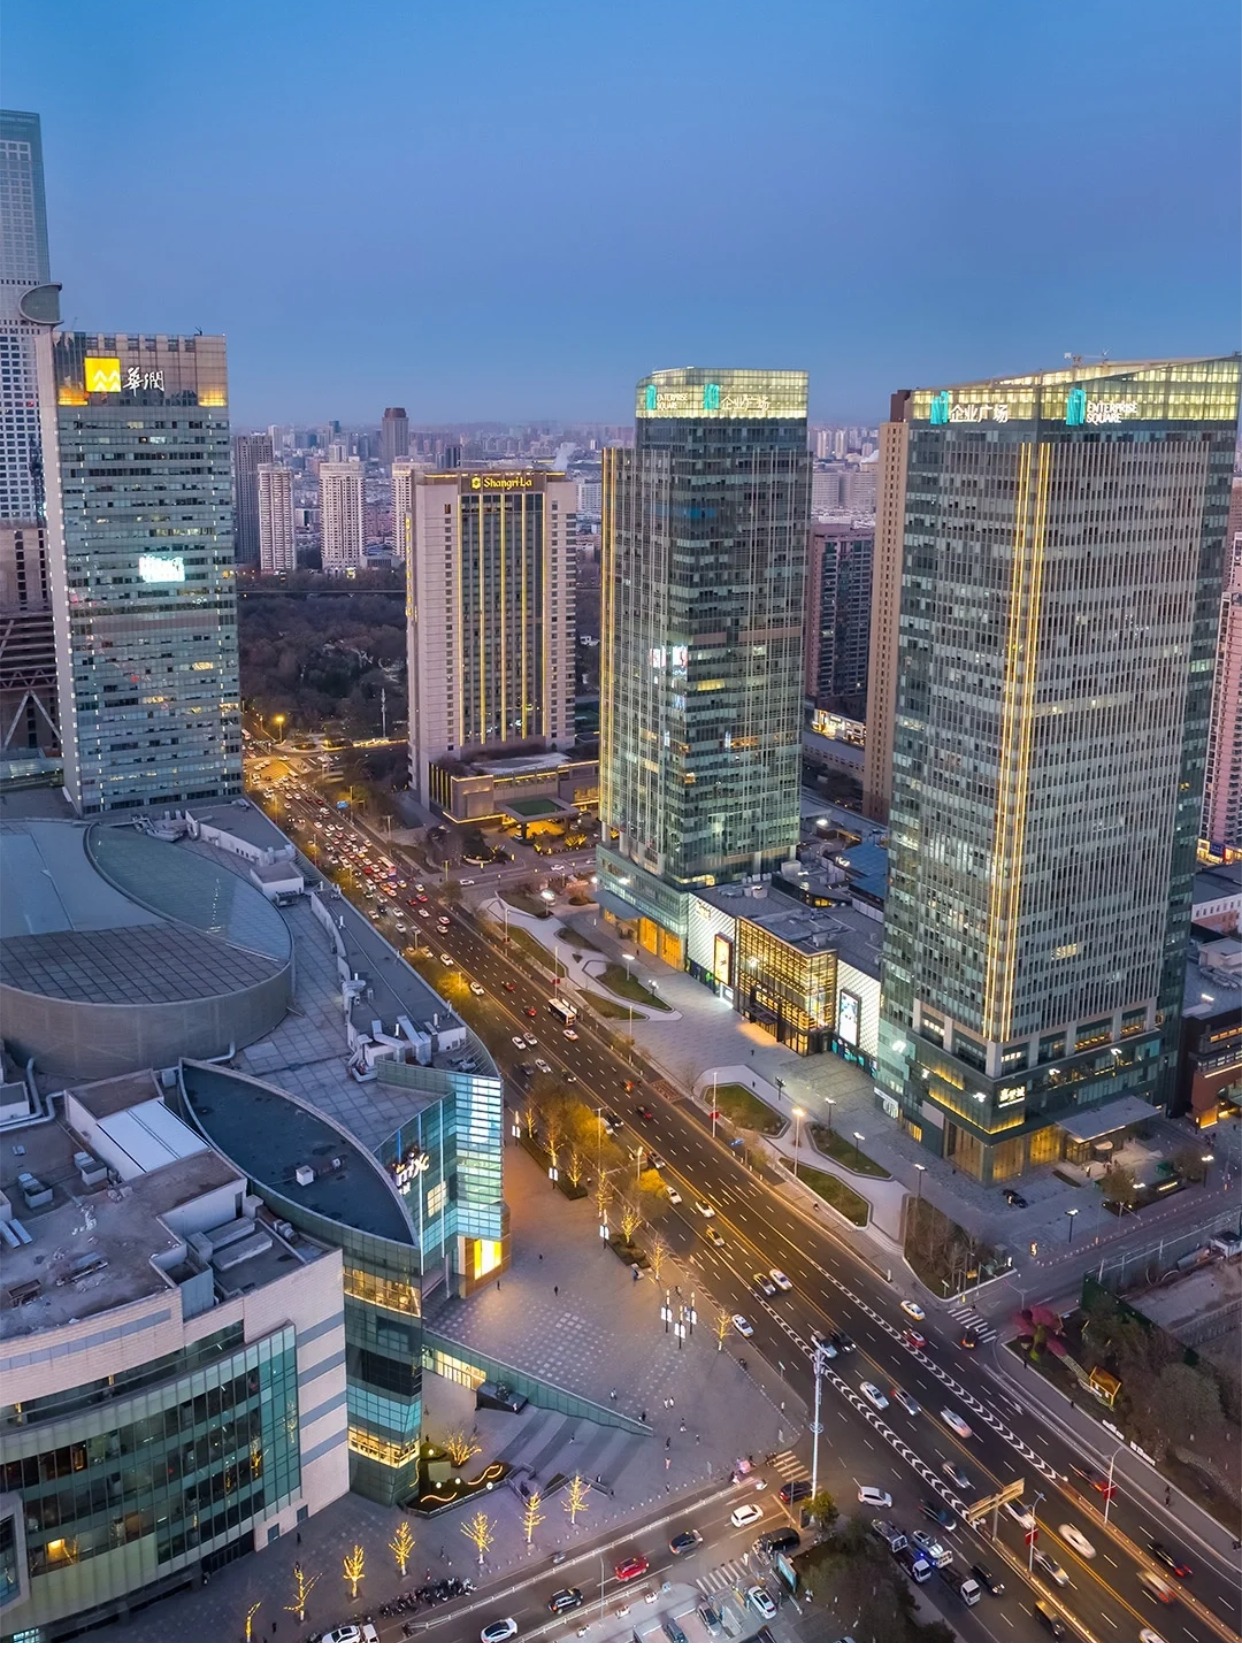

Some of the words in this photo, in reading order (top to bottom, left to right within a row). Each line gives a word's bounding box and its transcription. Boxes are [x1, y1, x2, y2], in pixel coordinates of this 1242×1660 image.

[1087, 400, 1137, 413] ENTERPRISE
[949, 404, 1008, 423] 企业广场
[1087, 413, 1121, 425] SQUARE
